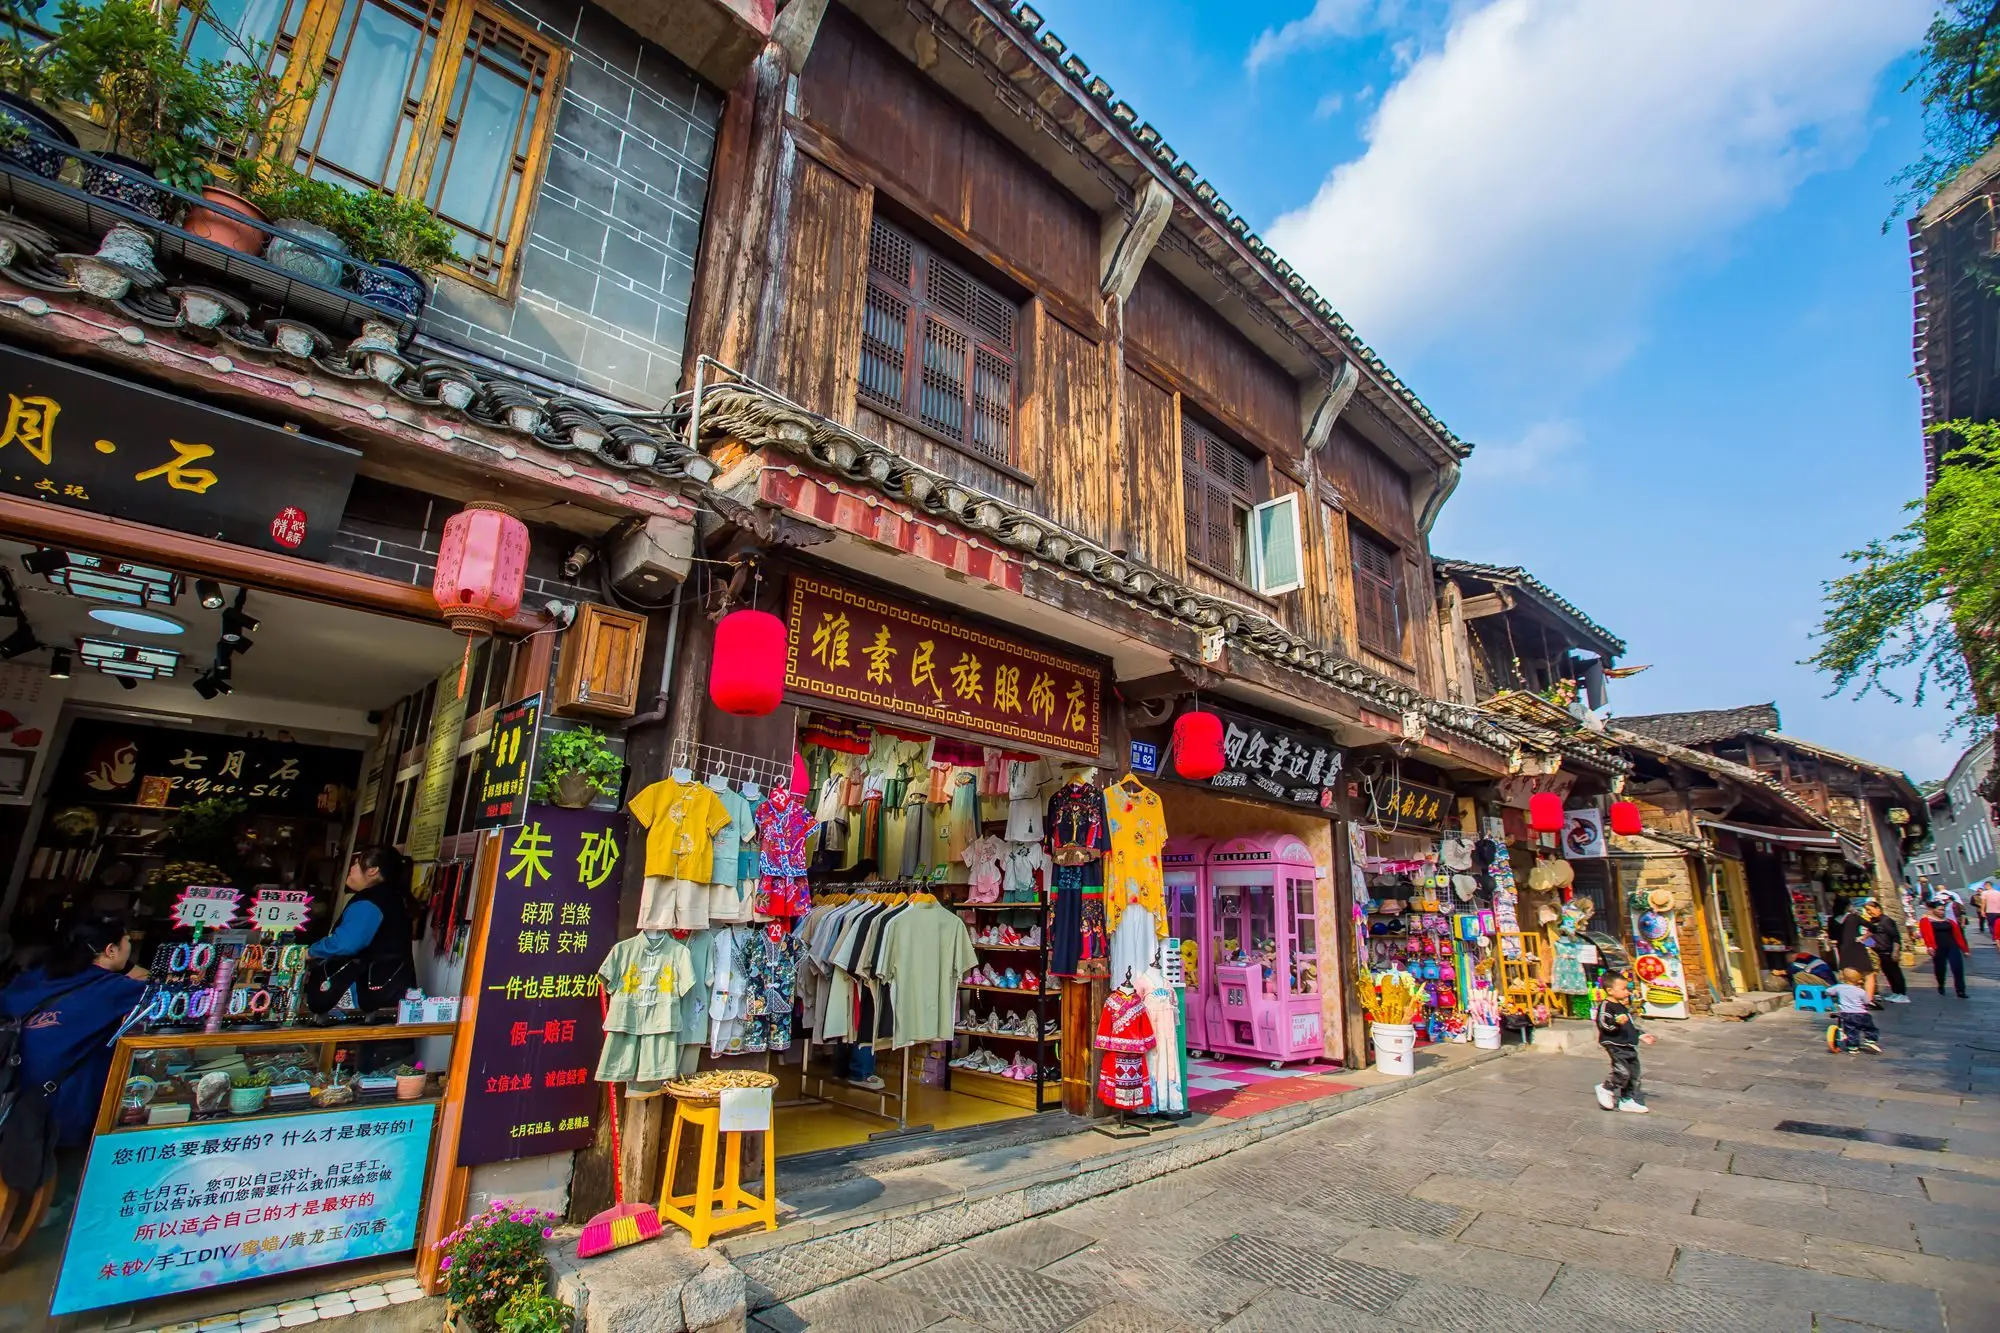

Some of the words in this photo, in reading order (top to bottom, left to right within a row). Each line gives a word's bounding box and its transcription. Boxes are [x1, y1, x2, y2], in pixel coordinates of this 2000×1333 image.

[811, 611, 1087, 733] 雅素民族服饰店
[1142, 754, 1152, 766] 62
[505, 821, 621, 890] 朱砂
[1213, 852, 1272, 861] TELEPHONE
[190, 887, 234, 900] 特价
[261, 890, 306, 902] 特价
[520, 902, 554, 925] 辟邪
[560, 902, 592, 925] 挡煞
[517, 931, 551, 954] 镇惊
[557, 930, 588, 954] 安神
[488, 974, 602, 1000] 一件也是批发价
[510, 1019, 577, 1046] 假一赔百
[485, 1073, 533, 1094] 立信企业
[133, 1191, 375, 1242] 所以适合自己的才是最好的
